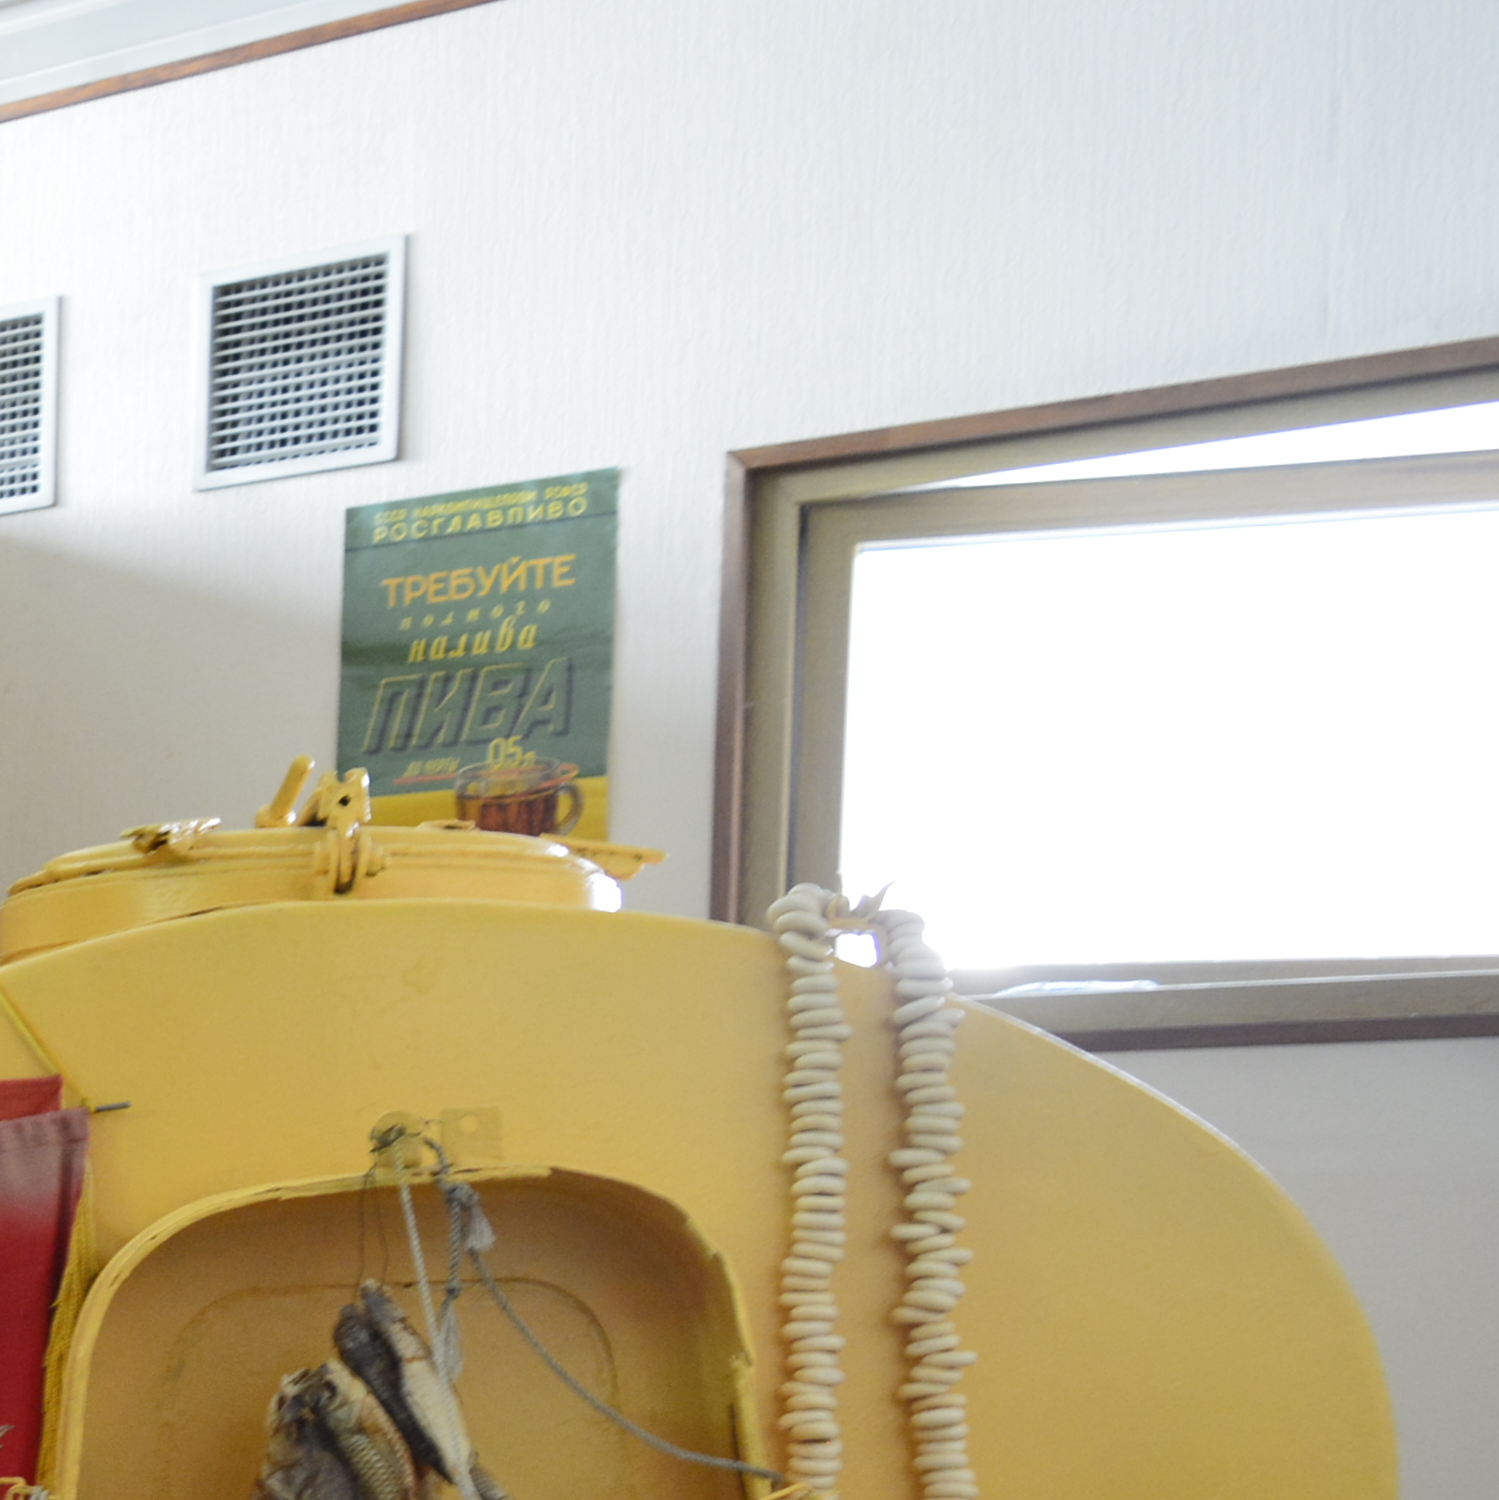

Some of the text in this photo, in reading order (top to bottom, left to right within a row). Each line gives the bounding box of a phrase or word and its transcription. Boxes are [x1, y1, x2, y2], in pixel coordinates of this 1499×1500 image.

[372, 496, 589, 545] РОСГЛАВПИВО
[380, 553, 577, 609] ТРЕБУЙТЕ
[399, 599, 552, 631] полного
[407, 614, 539, 664] налива
[362, 656, 575, 756] ПИВА
